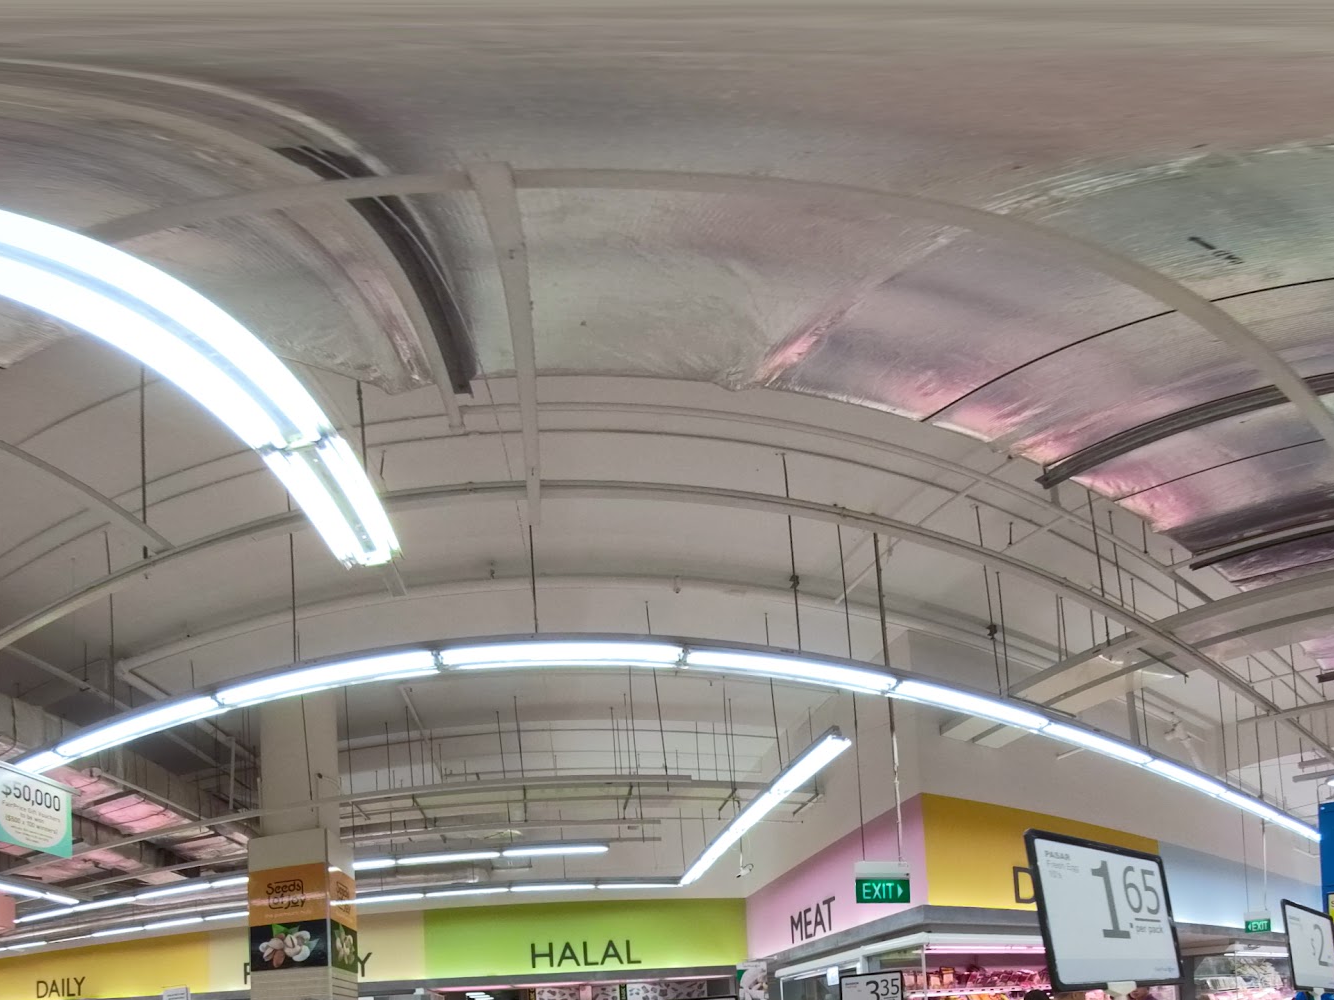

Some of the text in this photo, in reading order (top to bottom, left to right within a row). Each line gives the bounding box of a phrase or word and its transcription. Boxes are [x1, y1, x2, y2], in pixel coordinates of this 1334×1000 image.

[1, 782, 61, 812] $50,000
[1044, 850, 1071, 860] PASAR
[266, 881, 302, 895] Seeds
[862, 883, 894, 899] EXIT
[273, 893, 284, 905] of
[1091, 860, 1161, 939] 1.65
[790, 896, 835, 944] MEAT
[1252, 921, 1268, 930] EXIT
[1135, 925, 1164, 934] per pack
[530, 939, 642, 968] HALAL
[36, 977, 86, 999] DAILY
